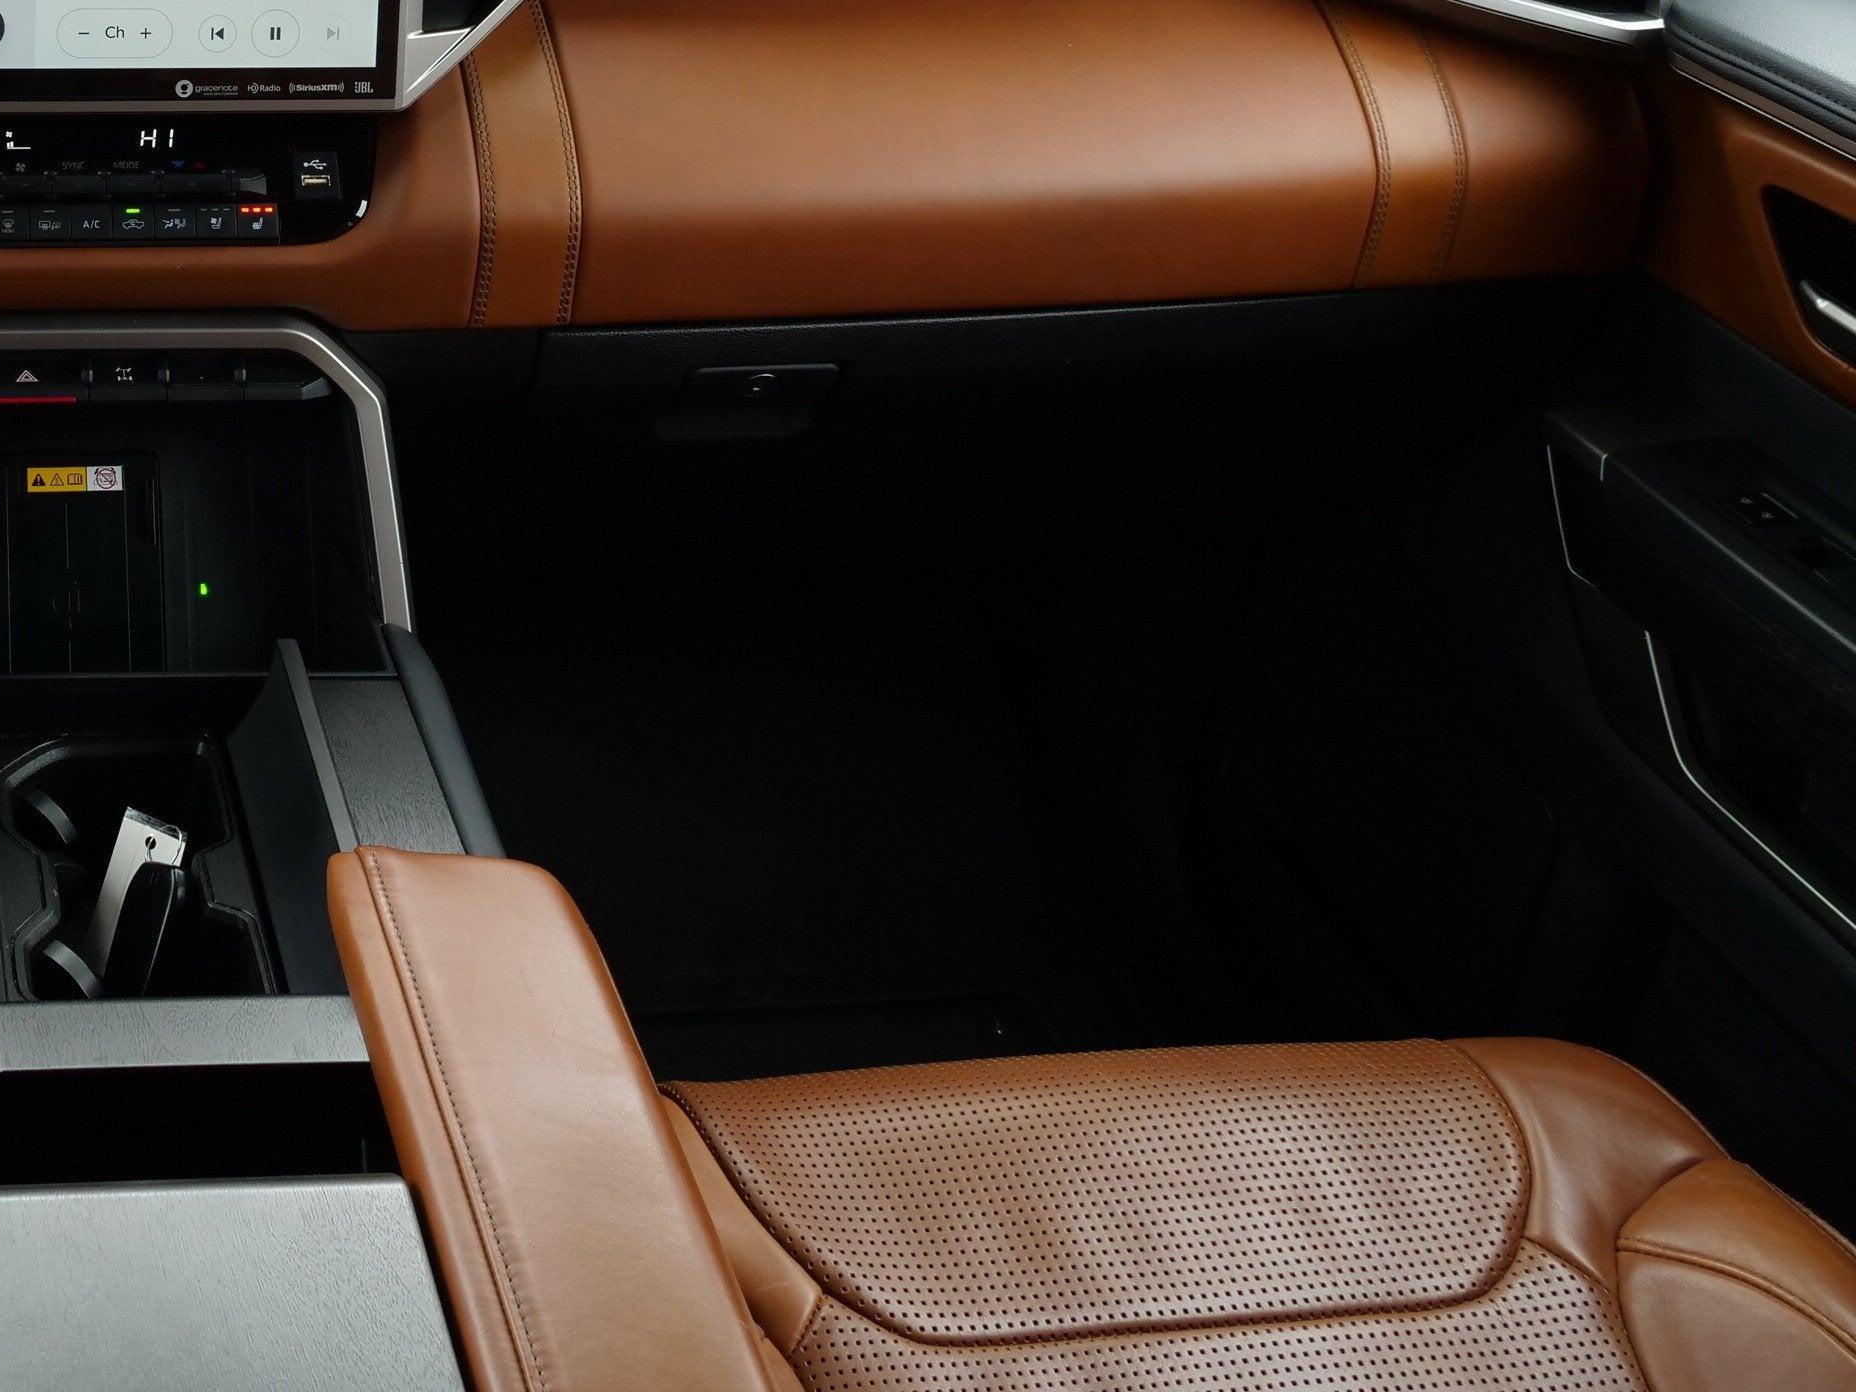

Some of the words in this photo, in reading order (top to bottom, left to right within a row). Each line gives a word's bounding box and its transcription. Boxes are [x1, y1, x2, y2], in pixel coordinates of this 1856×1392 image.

[104, 26, 125, 39] Ch
[194, 84, 238, 93] gracenote
[260, 84, 281, 92] Radio
[354, 82, 374, 94] JBL
[140, 128, 176, 150] HI
[61, 162, 86, 171] SYNC
[112, 160, 140, 170] MODE
[82, 219, 101, 230] A/C
